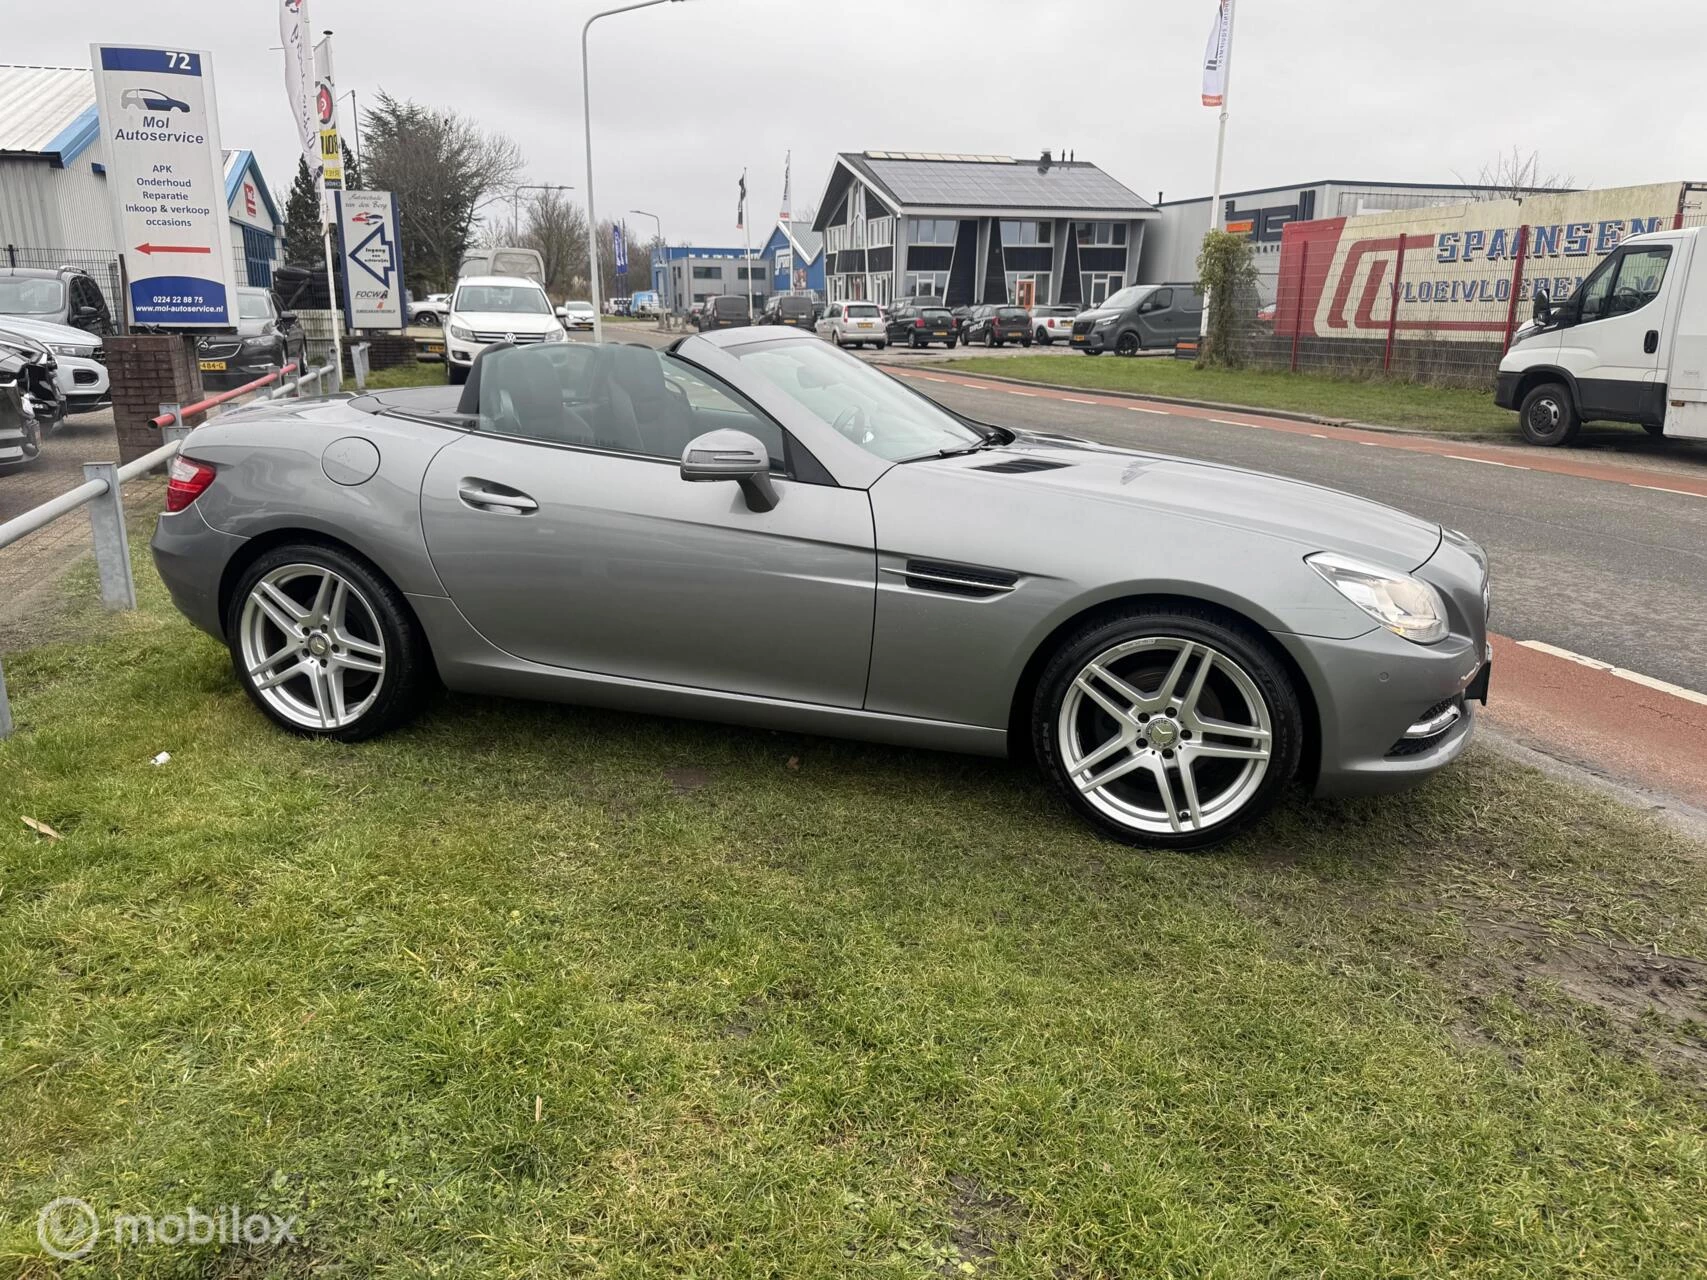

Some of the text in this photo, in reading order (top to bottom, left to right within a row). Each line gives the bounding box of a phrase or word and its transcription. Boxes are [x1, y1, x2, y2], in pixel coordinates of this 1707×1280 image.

[166, 51, 192, 70] 72
[142, 116, 170, 129] Mol
[115, 127, 204, 144] Autoservice
[152, 164, 173, 174] APK
[136, 177, 192, 188] Onderhoud
[142, 191, 189, 202] Reparatie
[125, 204, 210, 217] Inkoop & verkoop
[145, 217, 192, 227] occasions
[153, 295, 170, 303] 0224
[136, 304, 224, 314] www.mol-autoservice.nl
